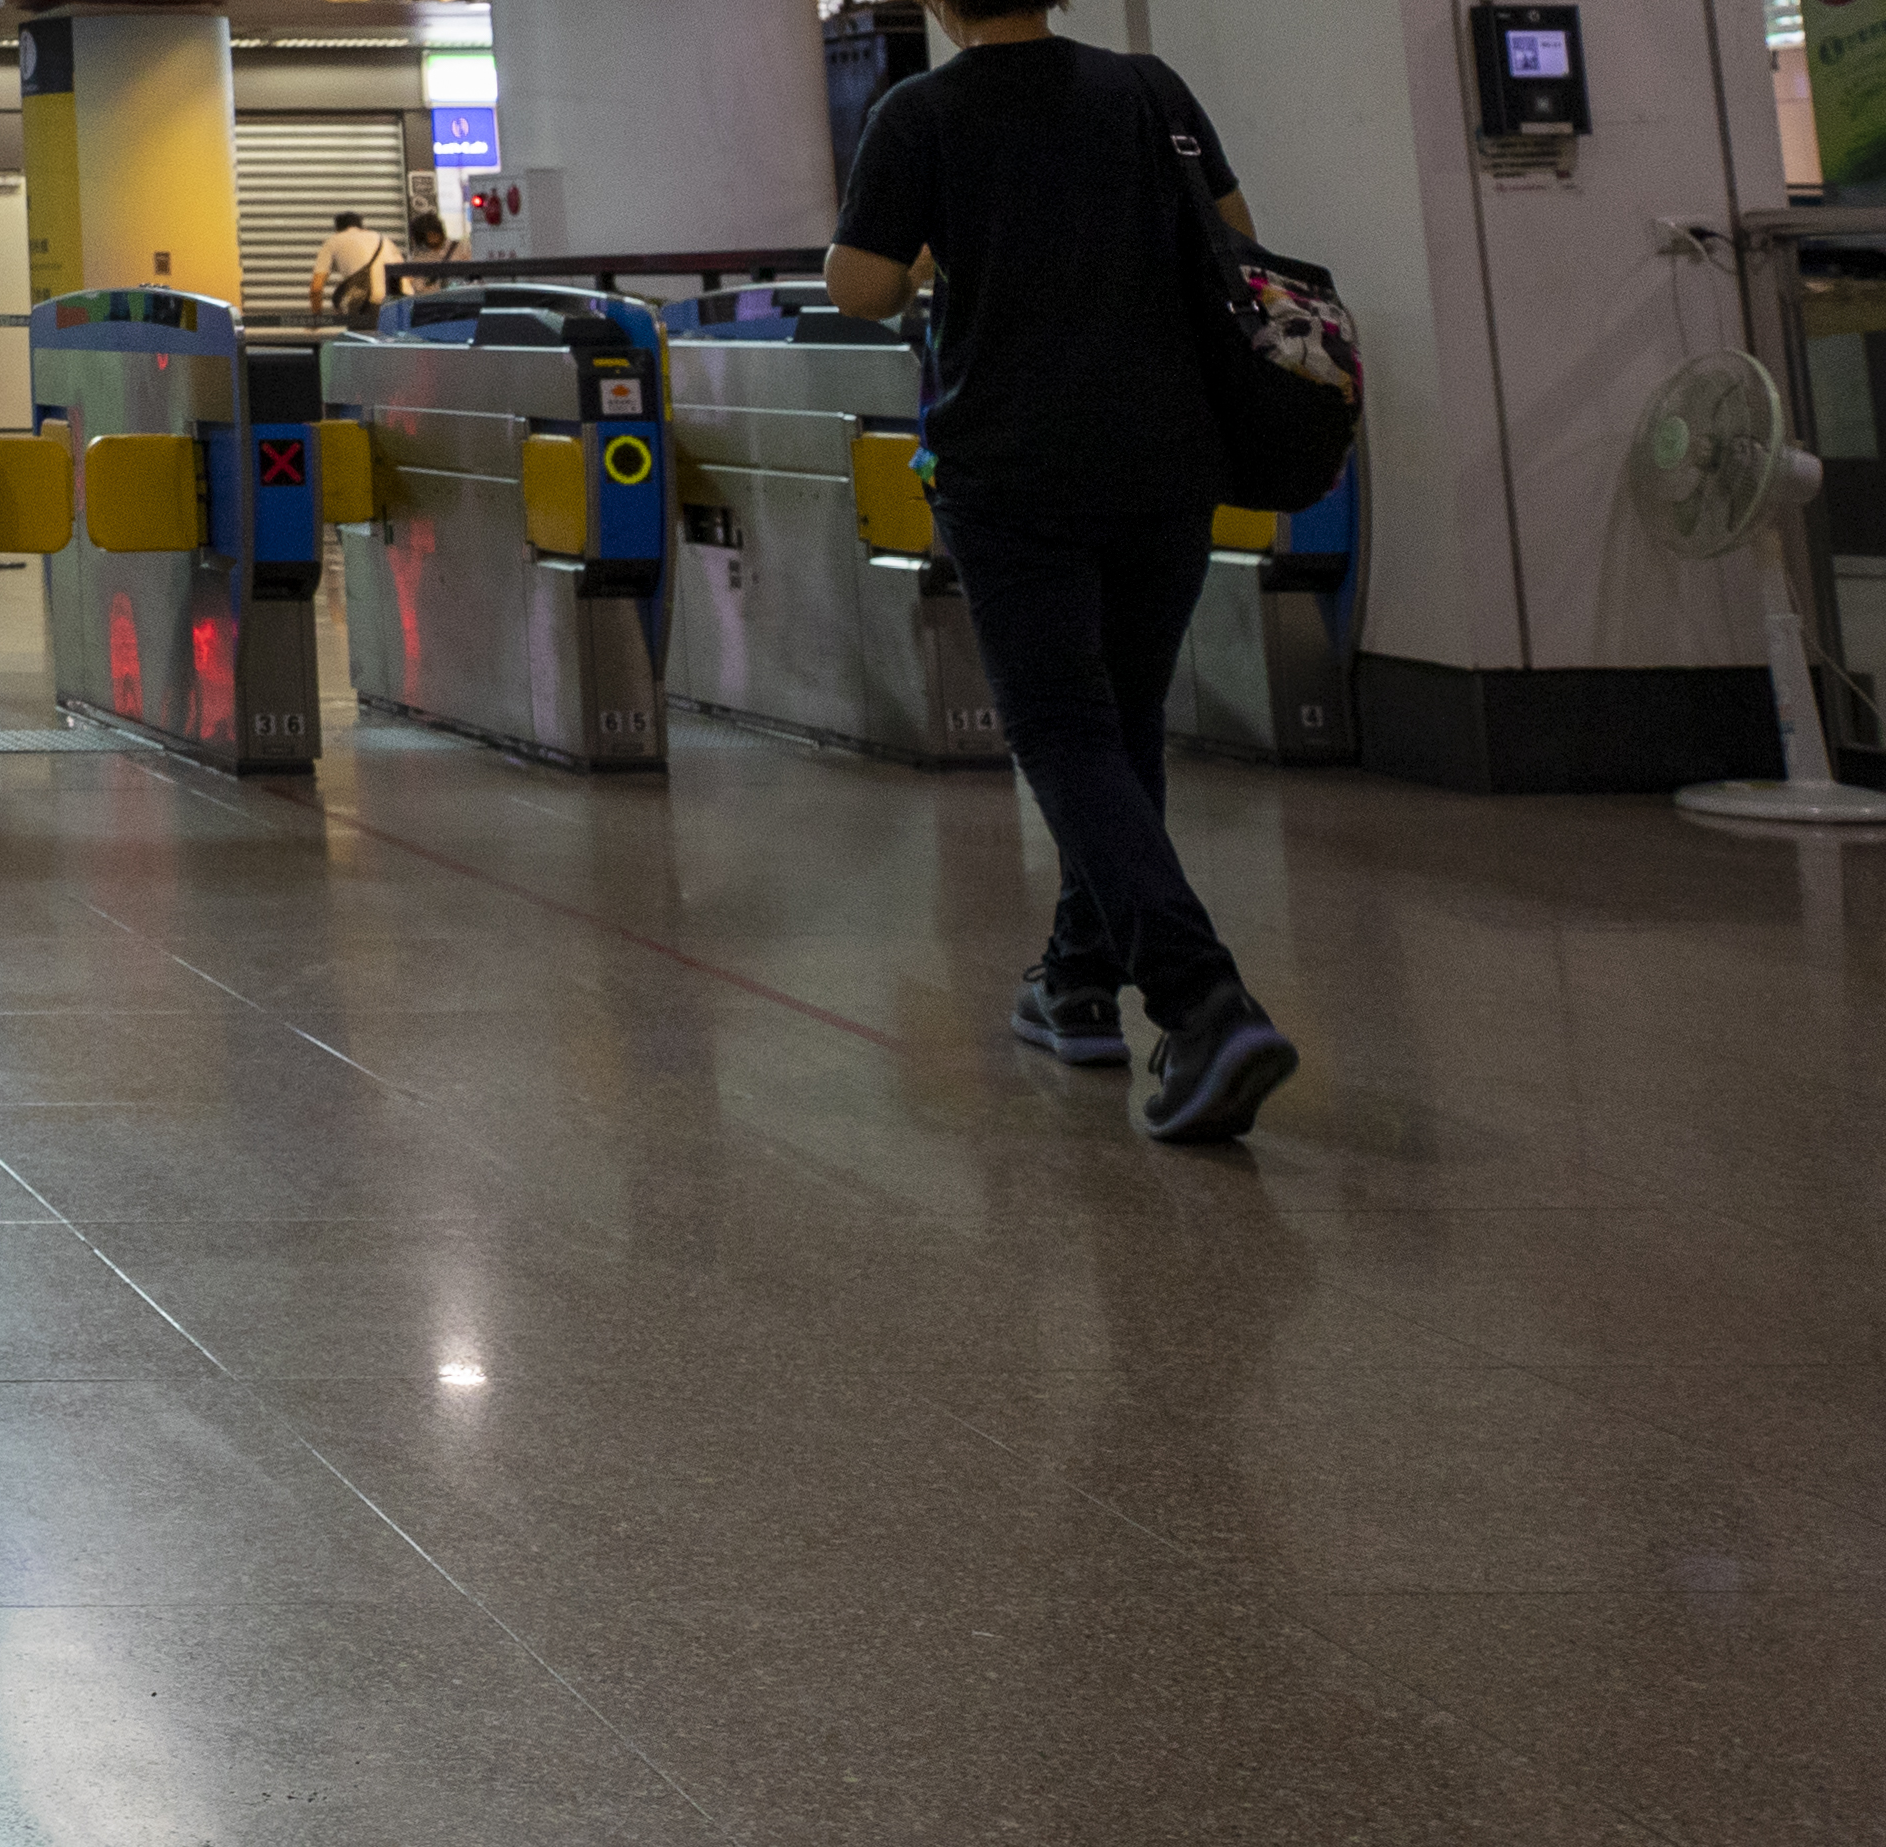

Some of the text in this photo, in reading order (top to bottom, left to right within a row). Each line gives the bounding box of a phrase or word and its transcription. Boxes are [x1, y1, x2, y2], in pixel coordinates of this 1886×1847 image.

[258, 715, 302, 735] 3 6
[978, 712, 994, 731] 4
